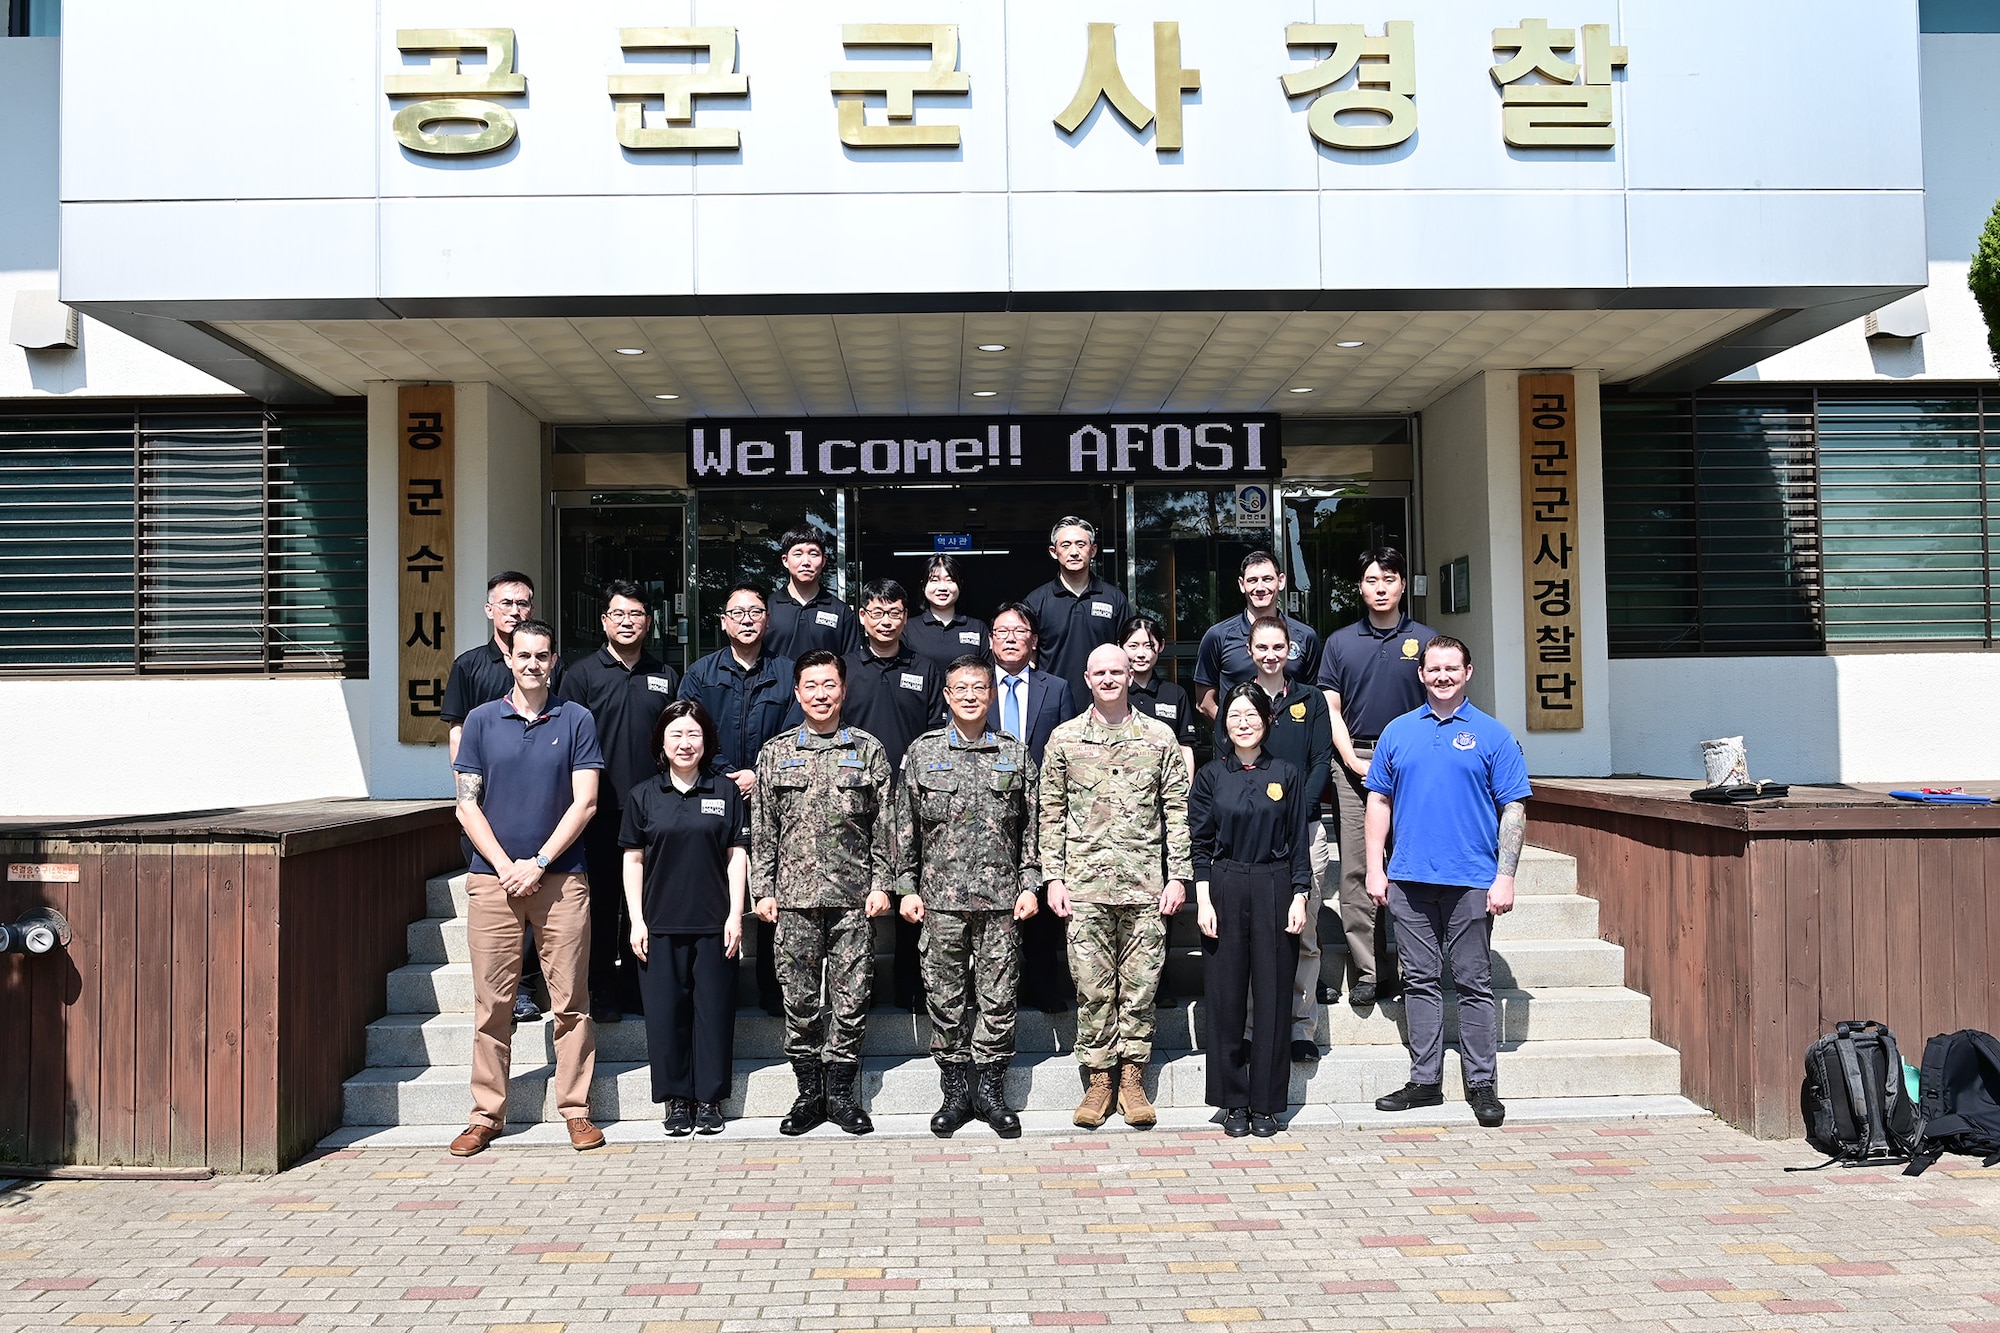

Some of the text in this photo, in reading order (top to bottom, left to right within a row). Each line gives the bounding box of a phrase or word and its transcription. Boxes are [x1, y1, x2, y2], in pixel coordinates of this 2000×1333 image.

[386, 19, 1628, 155] 공군군사경찰
[692, 422, 1266, 476] Welcome!! AFOSI
[405, 412, 446, 717] 공군수사단
[937, 537, 968, 546] 역사관
[1531, 393, 1577, 710] 공군군사경찰단
